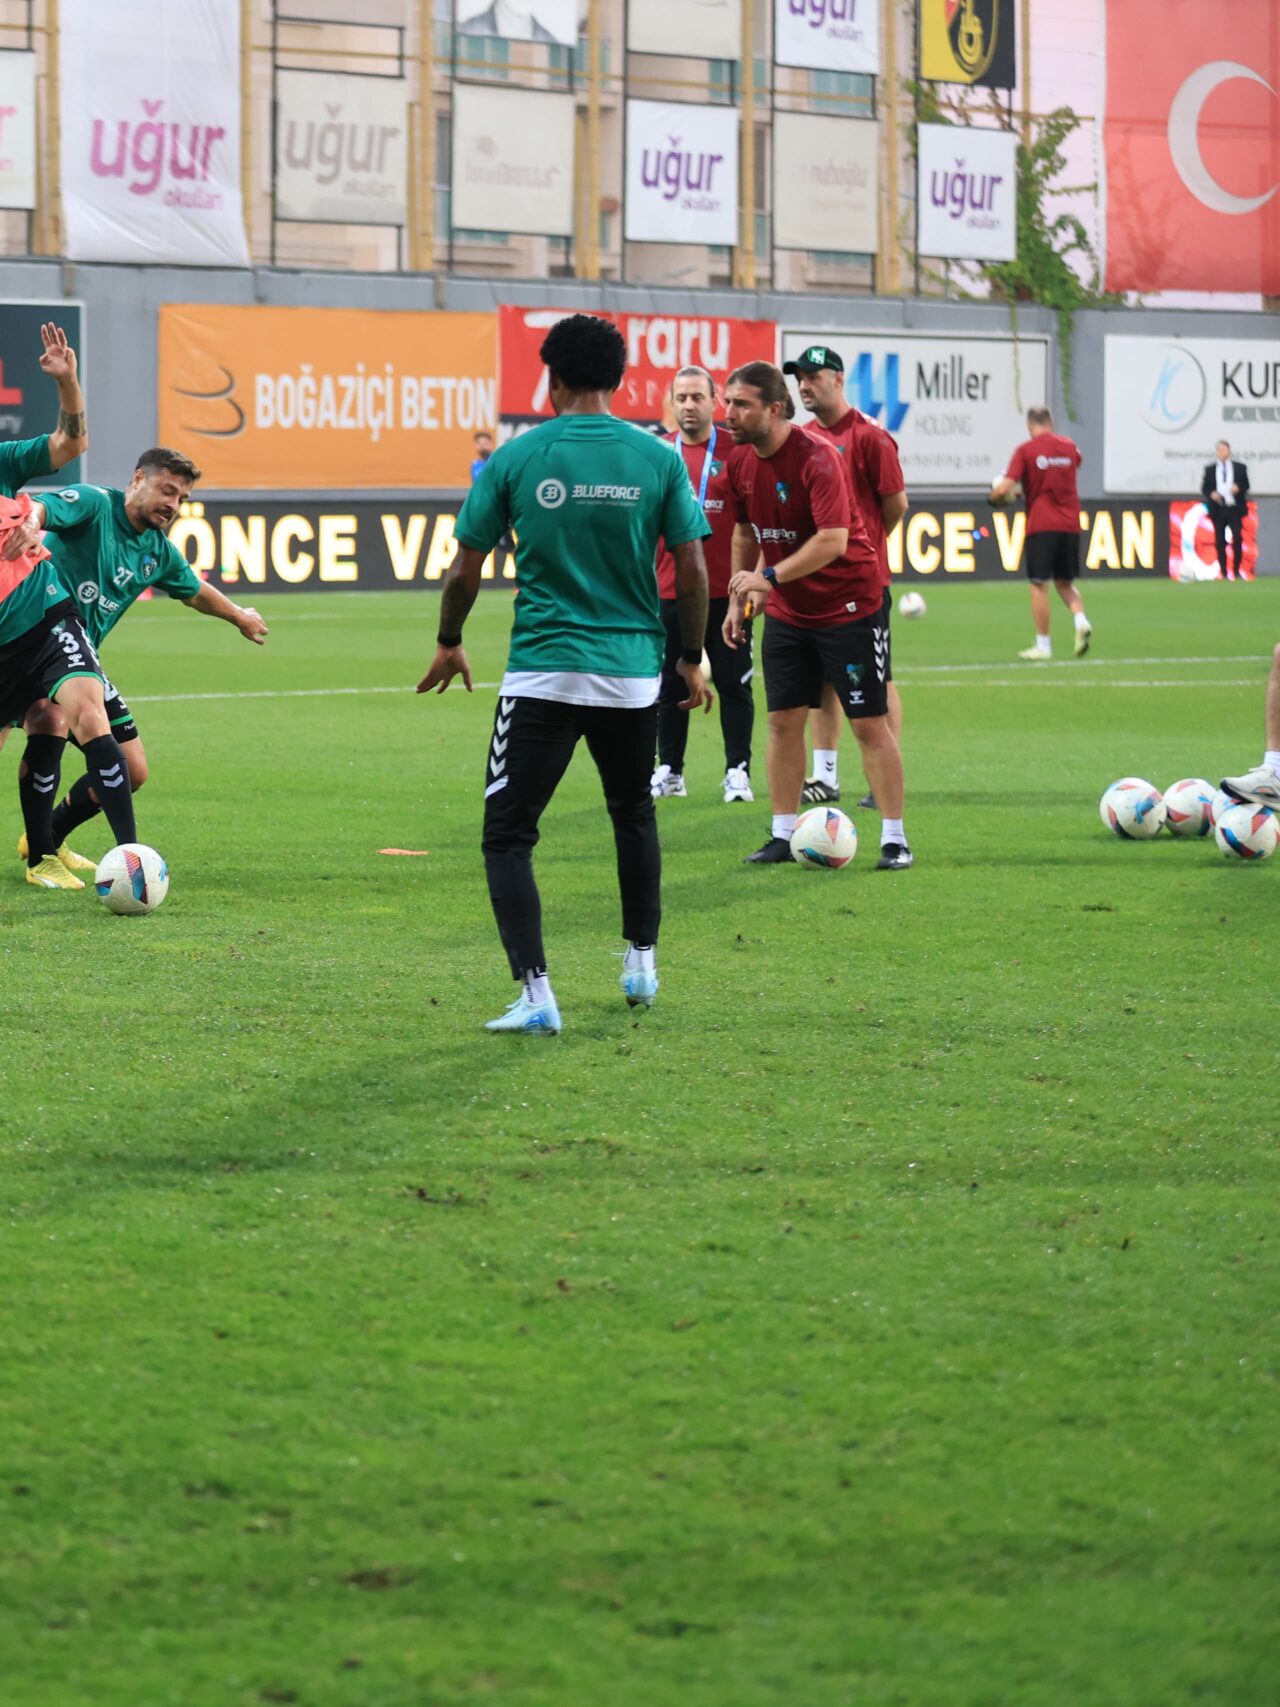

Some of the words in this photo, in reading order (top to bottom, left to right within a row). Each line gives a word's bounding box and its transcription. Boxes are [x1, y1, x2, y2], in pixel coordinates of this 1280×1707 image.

[89, 99, 225, 196] uğur
[284, 103, 401, 185] uğur
[641, 136, 723, 201] uğur
[931, 158, 1003, 219] uğur
[627, 317, 731, 370] raru
[255, 363, 394, 442] BOĞAZİÇİ
[401, 376, 496, 430] BETON
[915, 354, 990, 401] Miller
[914, 414, 973, 436] HOLDING
[1231, 406, 1280, 421] AL
[572, 484, 642, 501] BLUEFORCE
[113, 566, 134, 588] 27
[58, 631, 81, 654] 3
